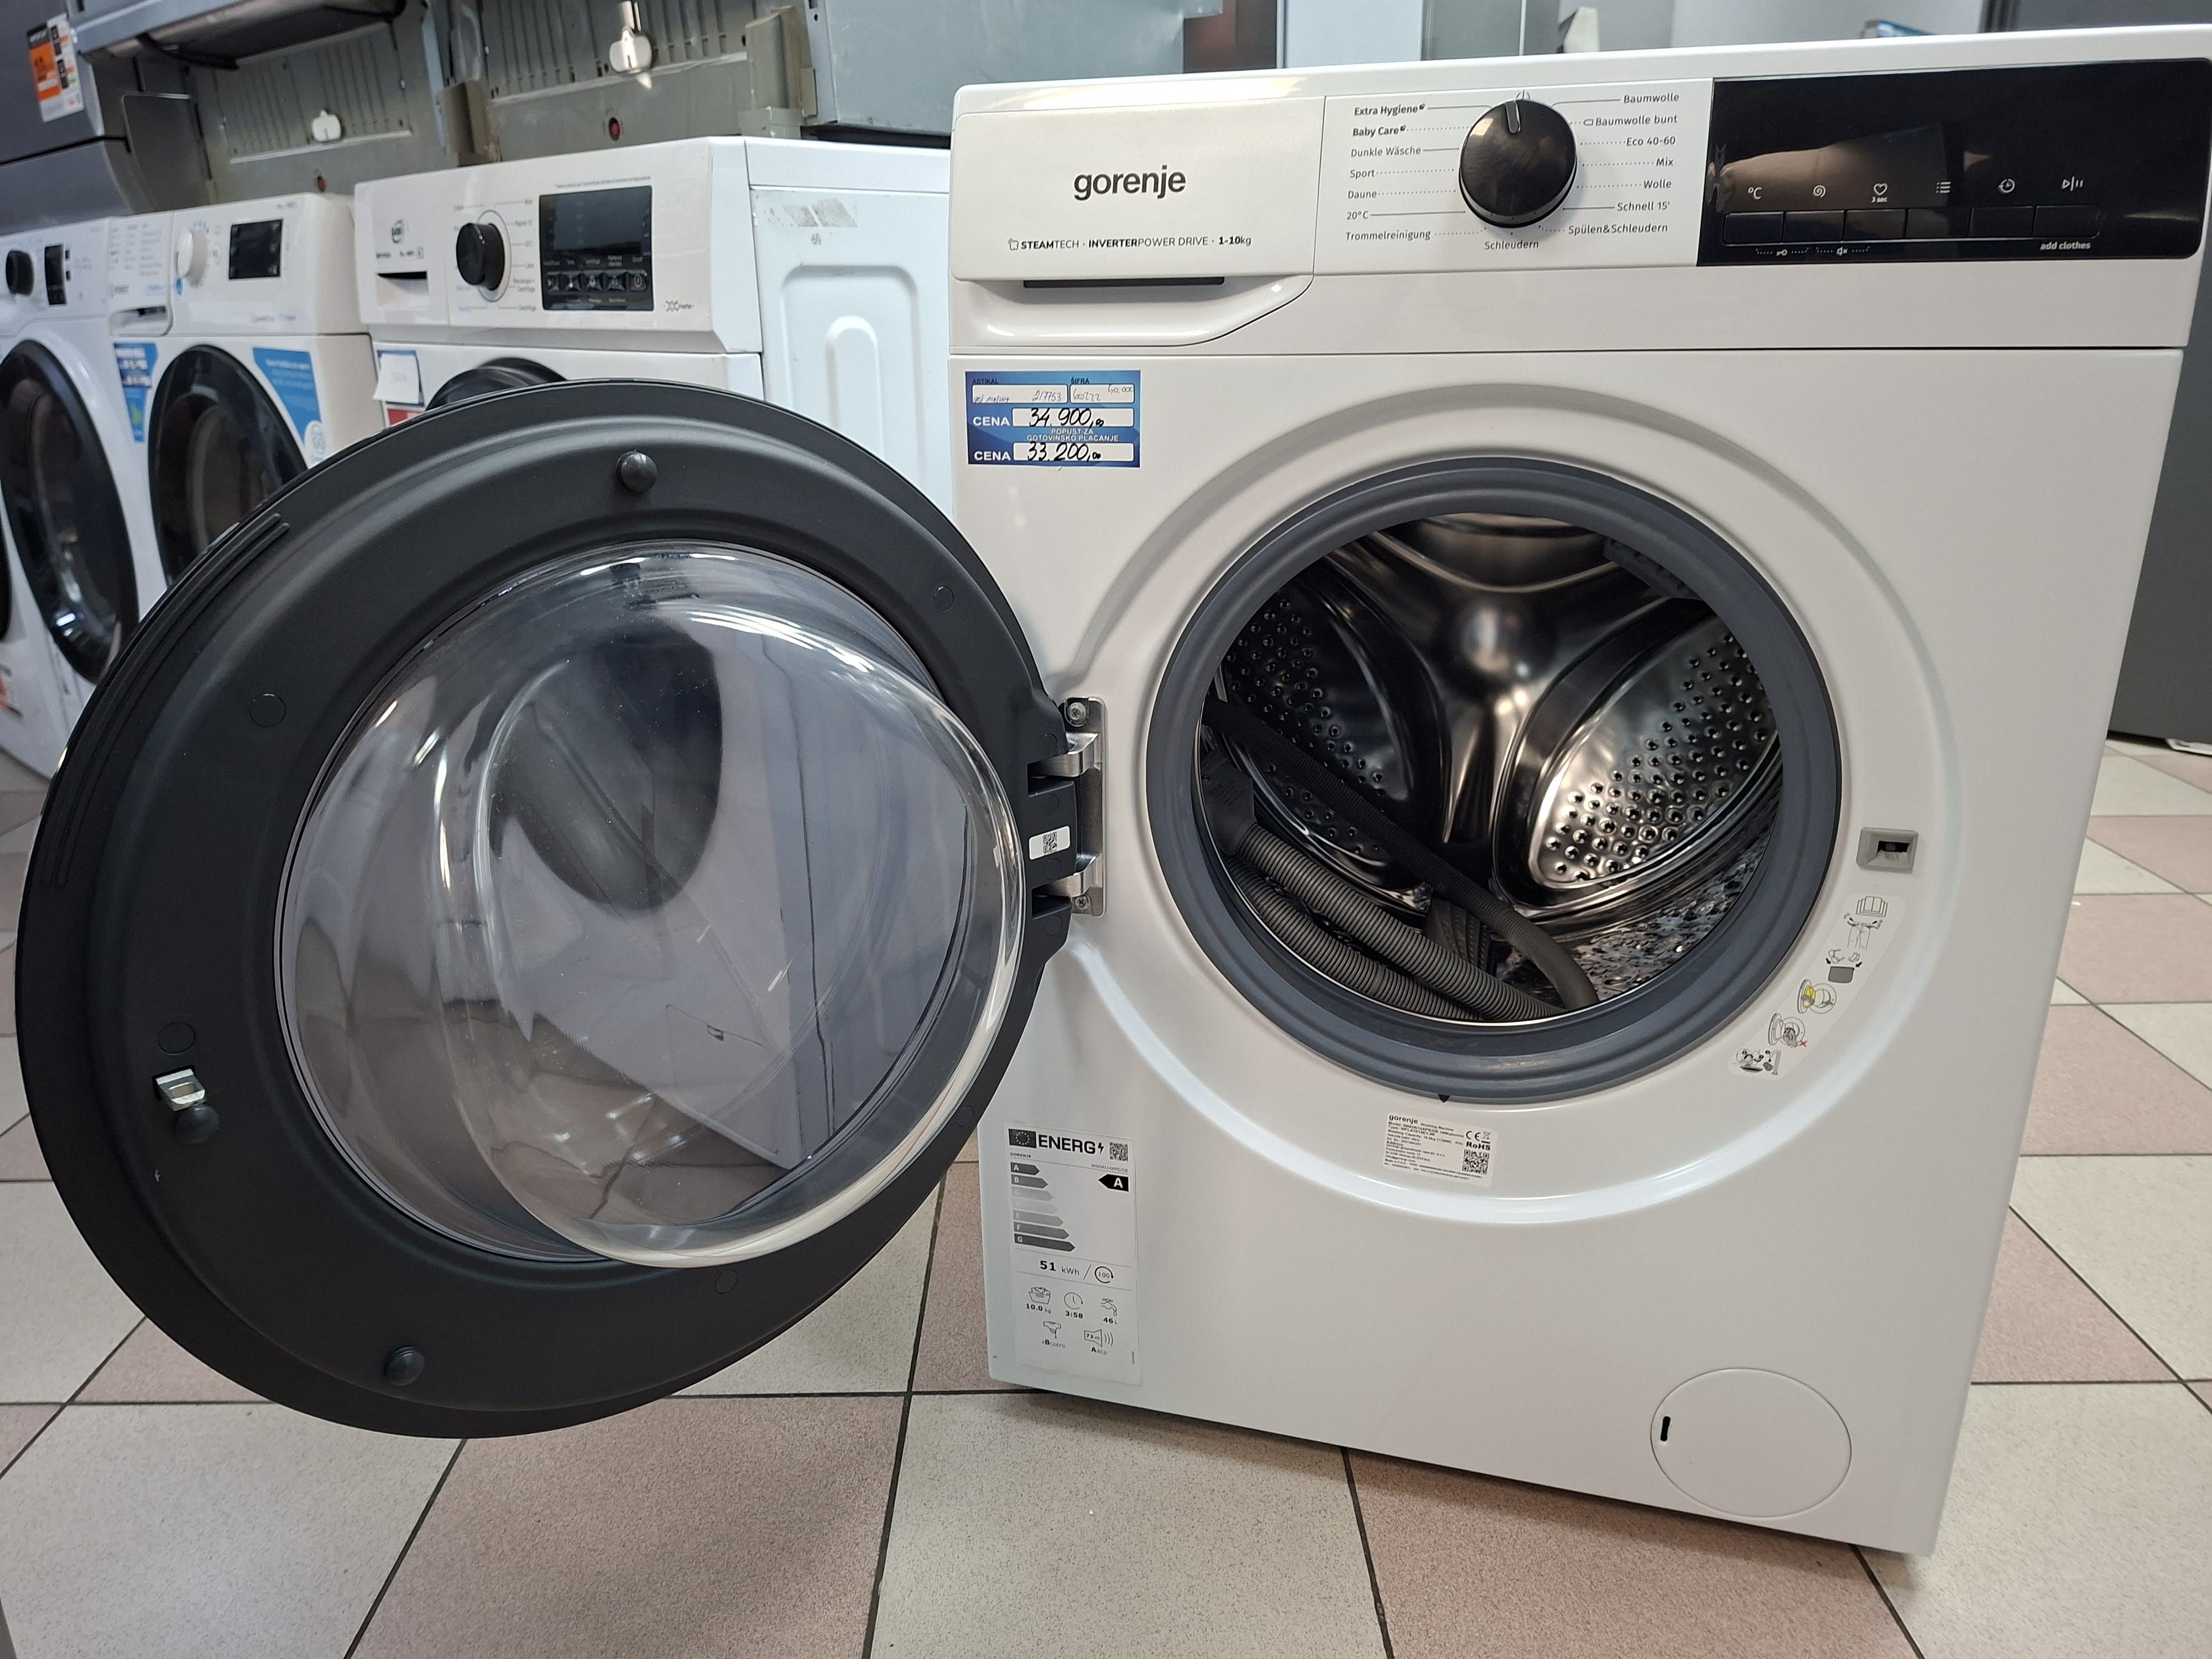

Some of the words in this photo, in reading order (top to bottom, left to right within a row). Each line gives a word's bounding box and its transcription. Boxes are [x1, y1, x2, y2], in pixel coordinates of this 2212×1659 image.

[1624, 92, 1679, 103] Baumwolle
[1354, 106, 1378, 116] Extra
[1380, 104, 1417, 116] Hygiene
[1595, 115, 1651, 126] Baumwolle
[1656, 114, 1678, 124] bunt
[1353, 126, 1376, 138] Baby
[1378, 126, 1399, 135] Care
[1626, 137, 1644, 147] Eco
[1646, 135, 1676, 146] 40-60
[1350, 147, 1383, 158] Dunkle
[1385, 145, 1421, 156] Wäsche
[1656, 157, 1674, 167] Mix
[1349, 168, 1375, 179] Sport
[1073, 165, 1186, 201] gorenje
[1644, 179, 1672, 189] Wolle
[1348, 189, 1377, 199] Daune
[1616, 201, 1652, 212] Schnell
[1656, 201, 1670, 211] 15'
[1347, 210, 1369, 220] 20°C
[1568, 223, 1668, 235] Spülen&Schleudern
[1346, 229, 1431, 241] Trommelreinigung
[1021, 239, 1079, 250] STEAMTECH
[1088, 237, 1175, 248] INVERTERPOWER
[1178, 236, 1208, 247] DRIVE
[1218, 236, 1251, 248] 1-10kg
[1484, 239, 1539, 251] Schleudern
[2040, 242, 2056, 251] add
[2059, 241, 2091, 250] clothes
[973, 417, 1010, 426] CENA
[974, 451, 1011, 461] CENA
[1389, 1115, 1418, 1124] gorenje
[1039, 1134, 1096, 1154] ENERG
[1466, 1141, 1490, 1151] RoHS
[1113, 1177, 1123, 1188] A
[1040, 1260, 1056, 1271] 51
[1061, 1266, 1079, 1276] kWh
[1065, 1311, 1083, 1319] 3:58
